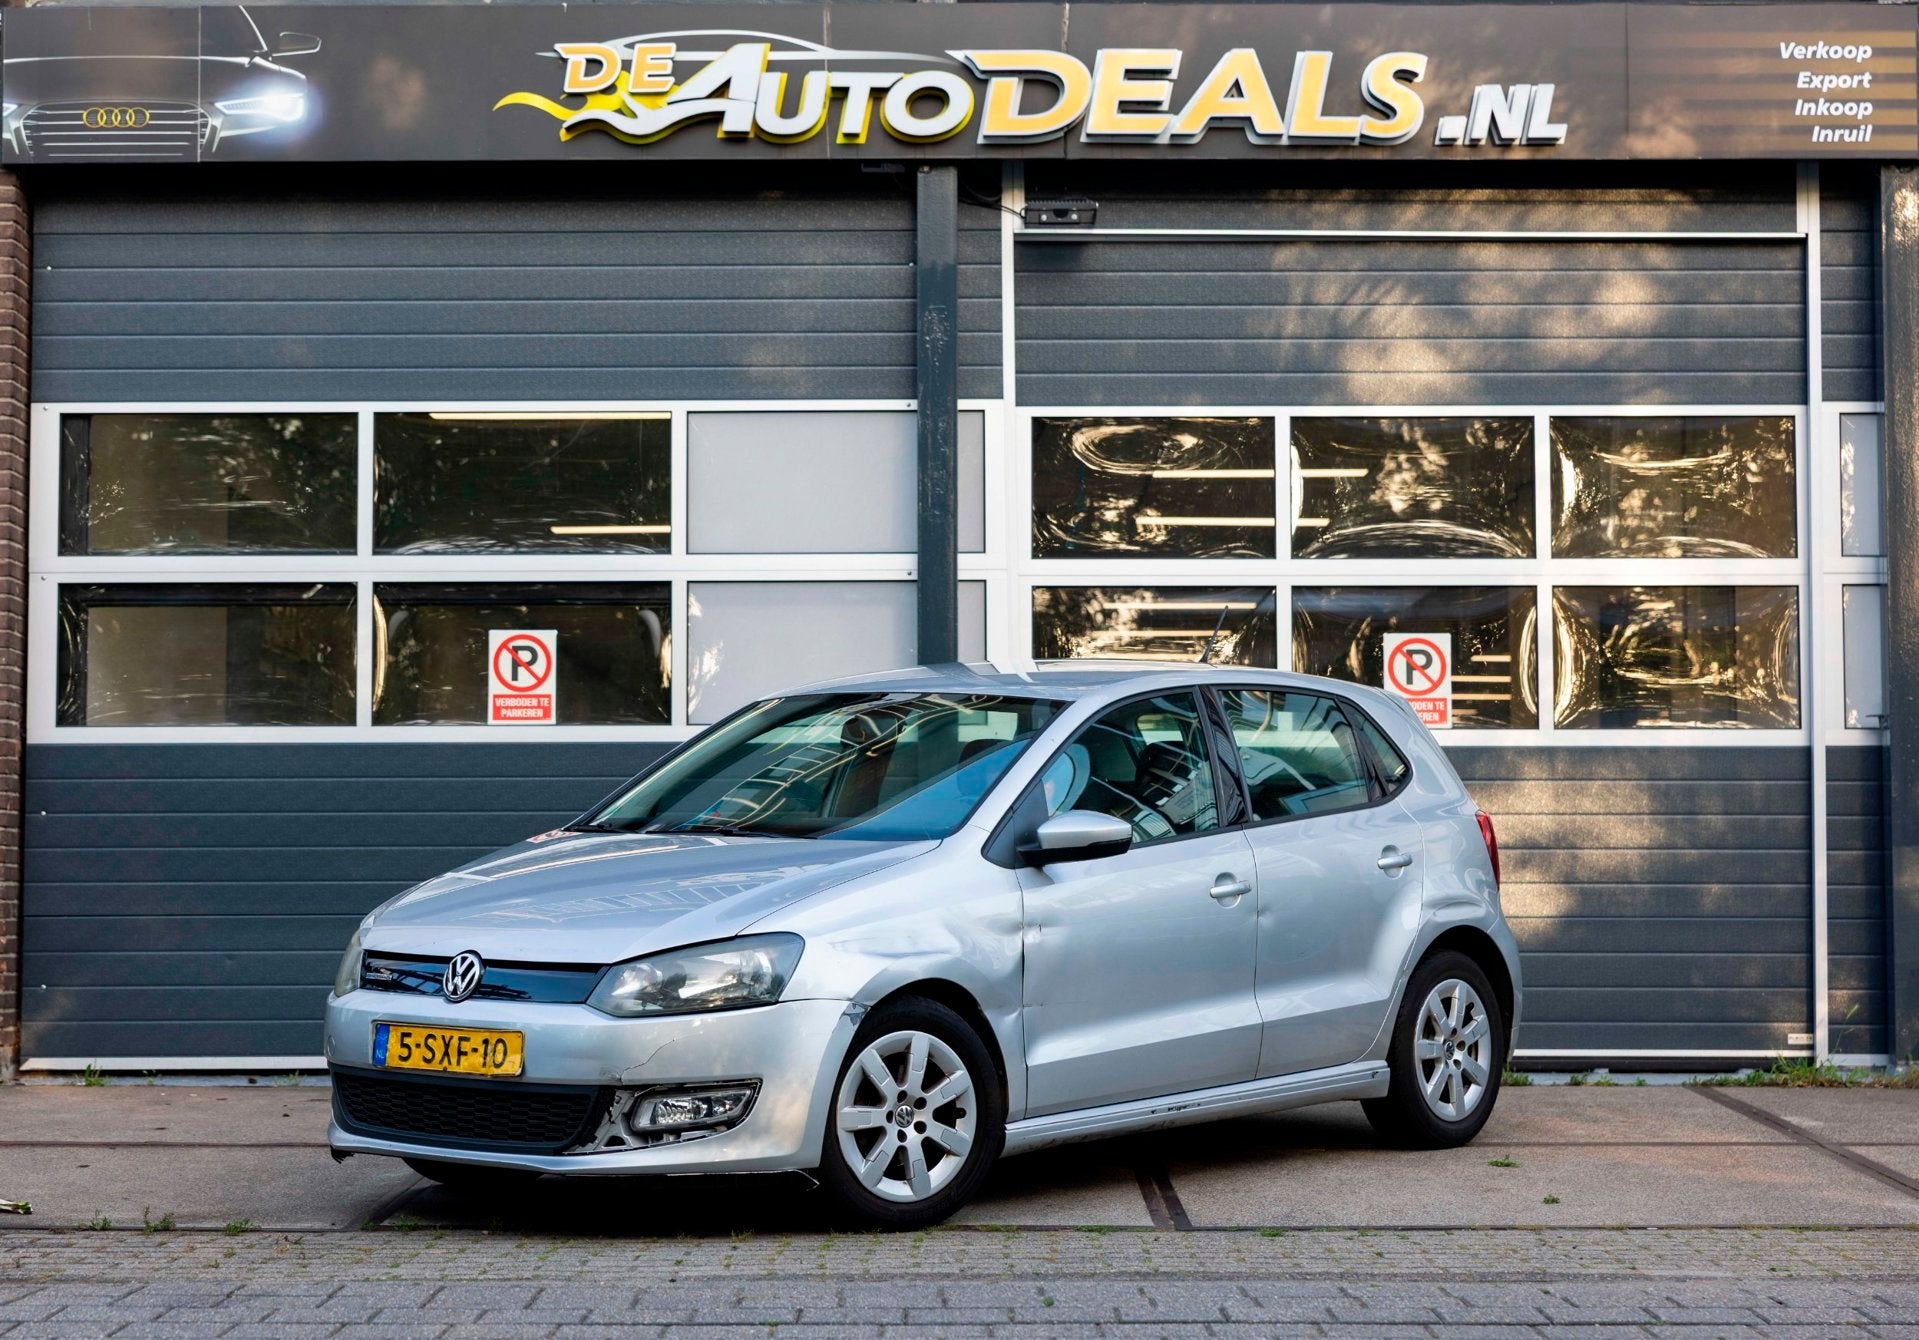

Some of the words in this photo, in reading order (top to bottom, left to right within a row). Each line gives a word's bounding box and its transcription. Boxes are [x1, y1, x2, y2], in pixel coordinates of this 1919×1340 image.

[1779, 40, 1873, 63] Verkoop
[1796, 71, 1873, 93] Export
[553, 42, 677, 94] DE
[945, 48, 1429, 145] DEALS
[1794, 97, 1874, 120] Inkoop
[1811, 124, 1873, 142] Inruil
[495, 697, 538, 707] VERBODEN
[538, 697, 550, 707] TE
[501, 708, 544, 717] PARKEREN
[1434, 701, 1446, 711] TE
[398, 1031, 508, 1069] 5-SXF-10
